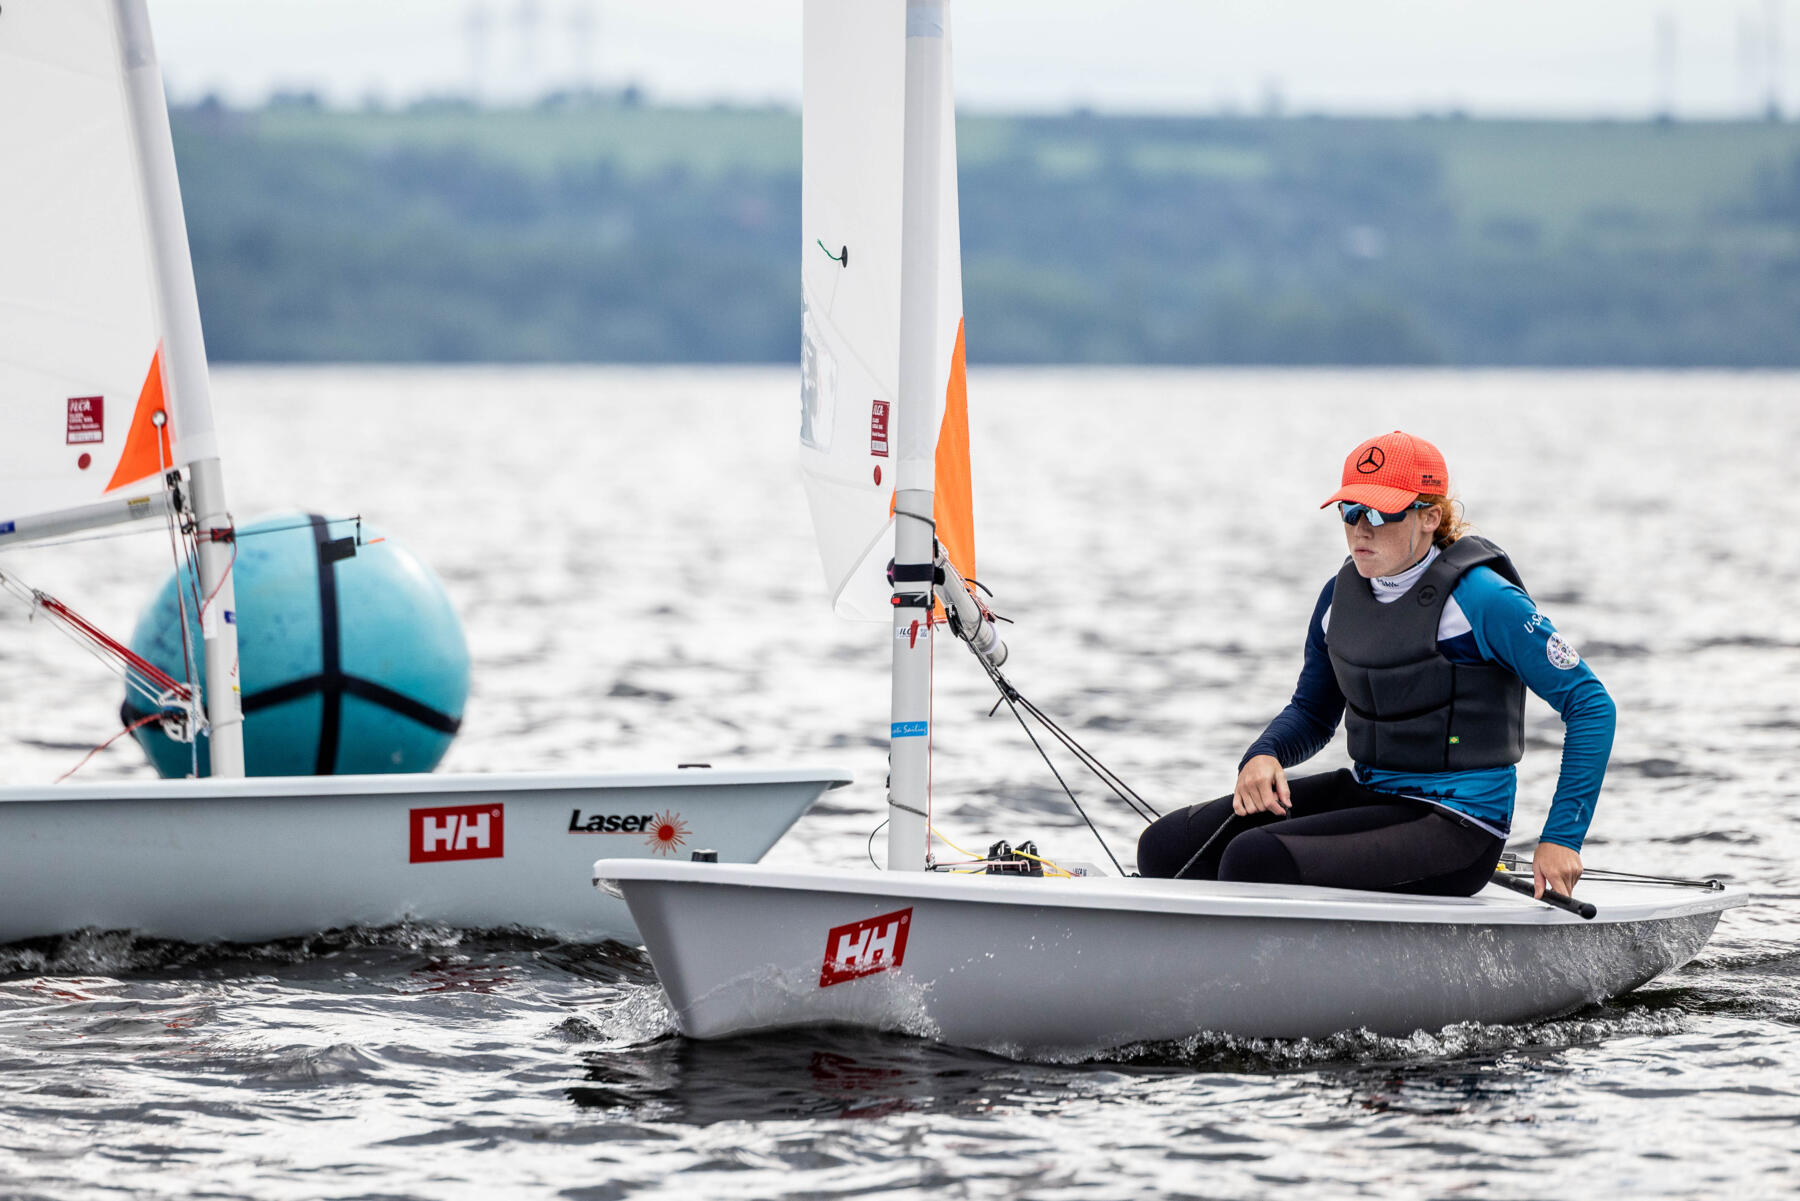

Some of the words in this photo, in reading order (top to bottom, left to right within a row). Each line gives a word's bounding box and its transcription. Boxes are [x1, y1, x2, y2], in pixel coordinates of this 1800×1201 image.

[423, 812, 490, 852] HH
[568, 809, 653, 832] Laser
[834, 921, 899, 973] HH
